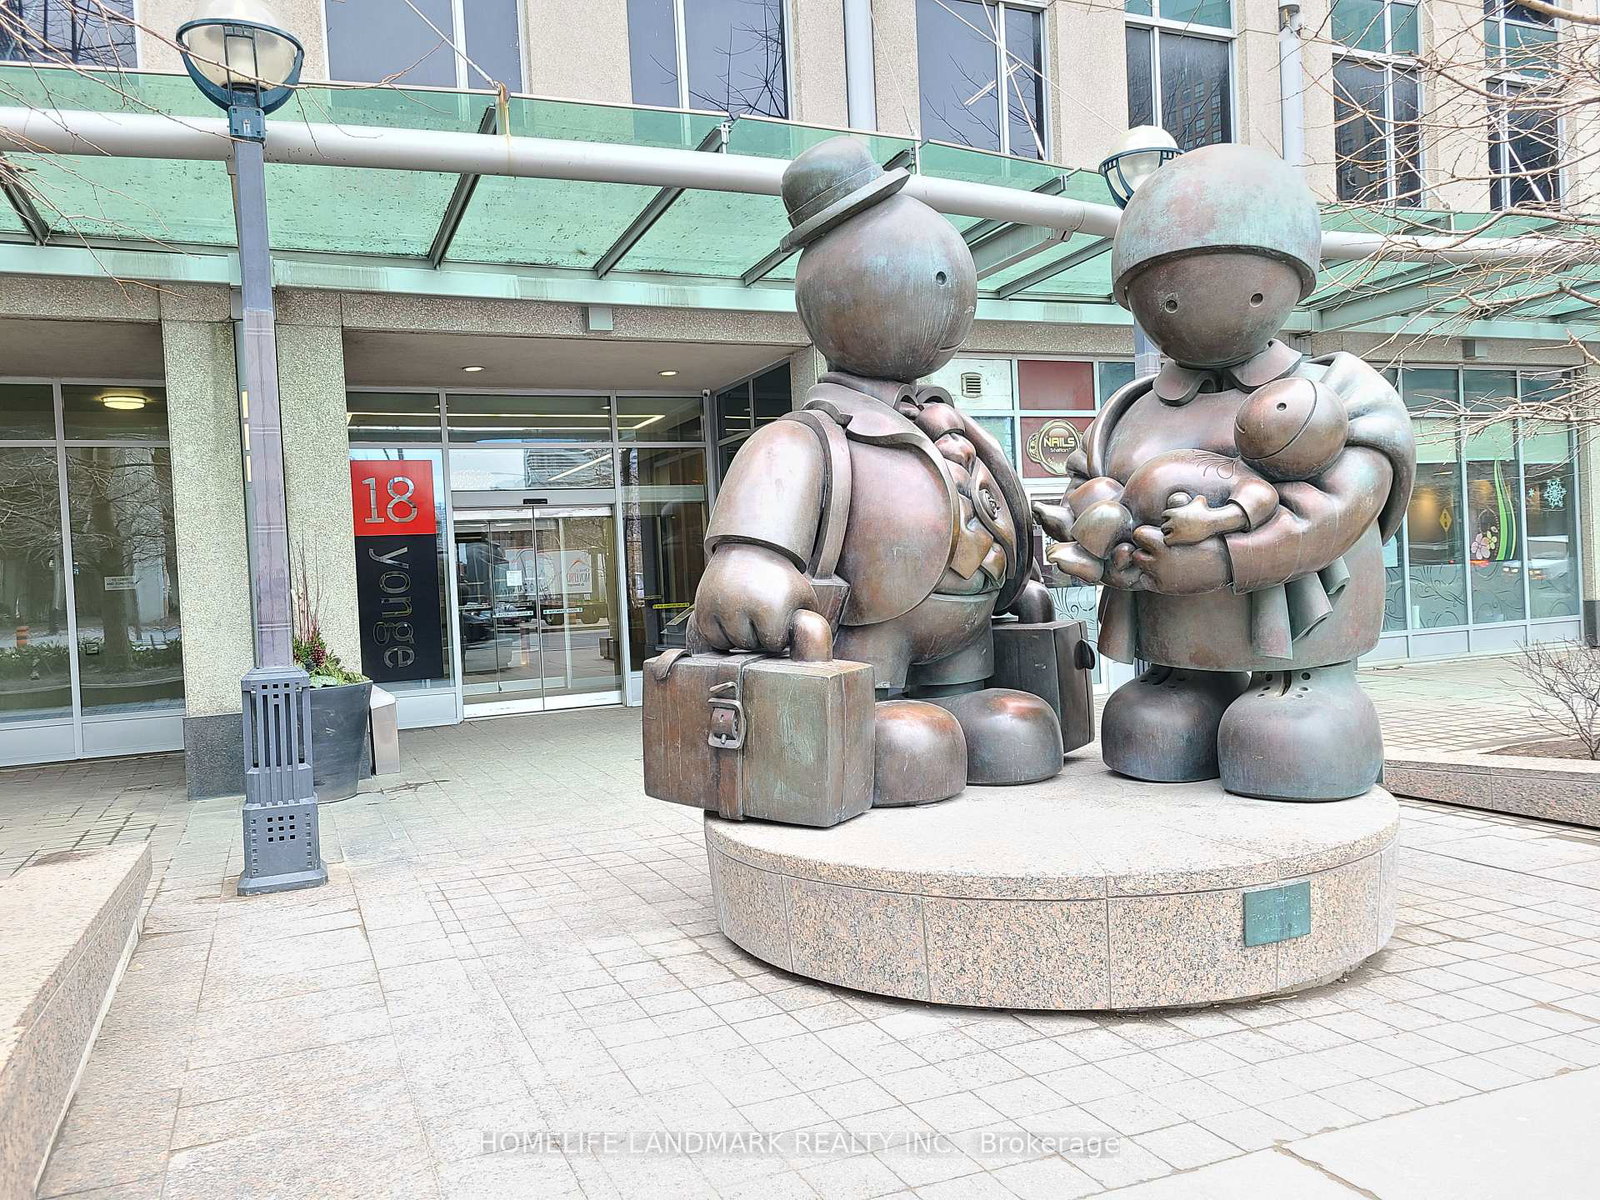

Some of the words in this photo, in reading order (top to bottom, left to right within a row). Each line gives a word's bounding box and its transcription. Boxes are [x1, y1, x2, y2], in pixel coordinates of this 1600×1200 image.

[1043, 437, 1075, 447] NAILS
[361, 477, 418, 523] 18
[368, 547, 415, 669] yonge
